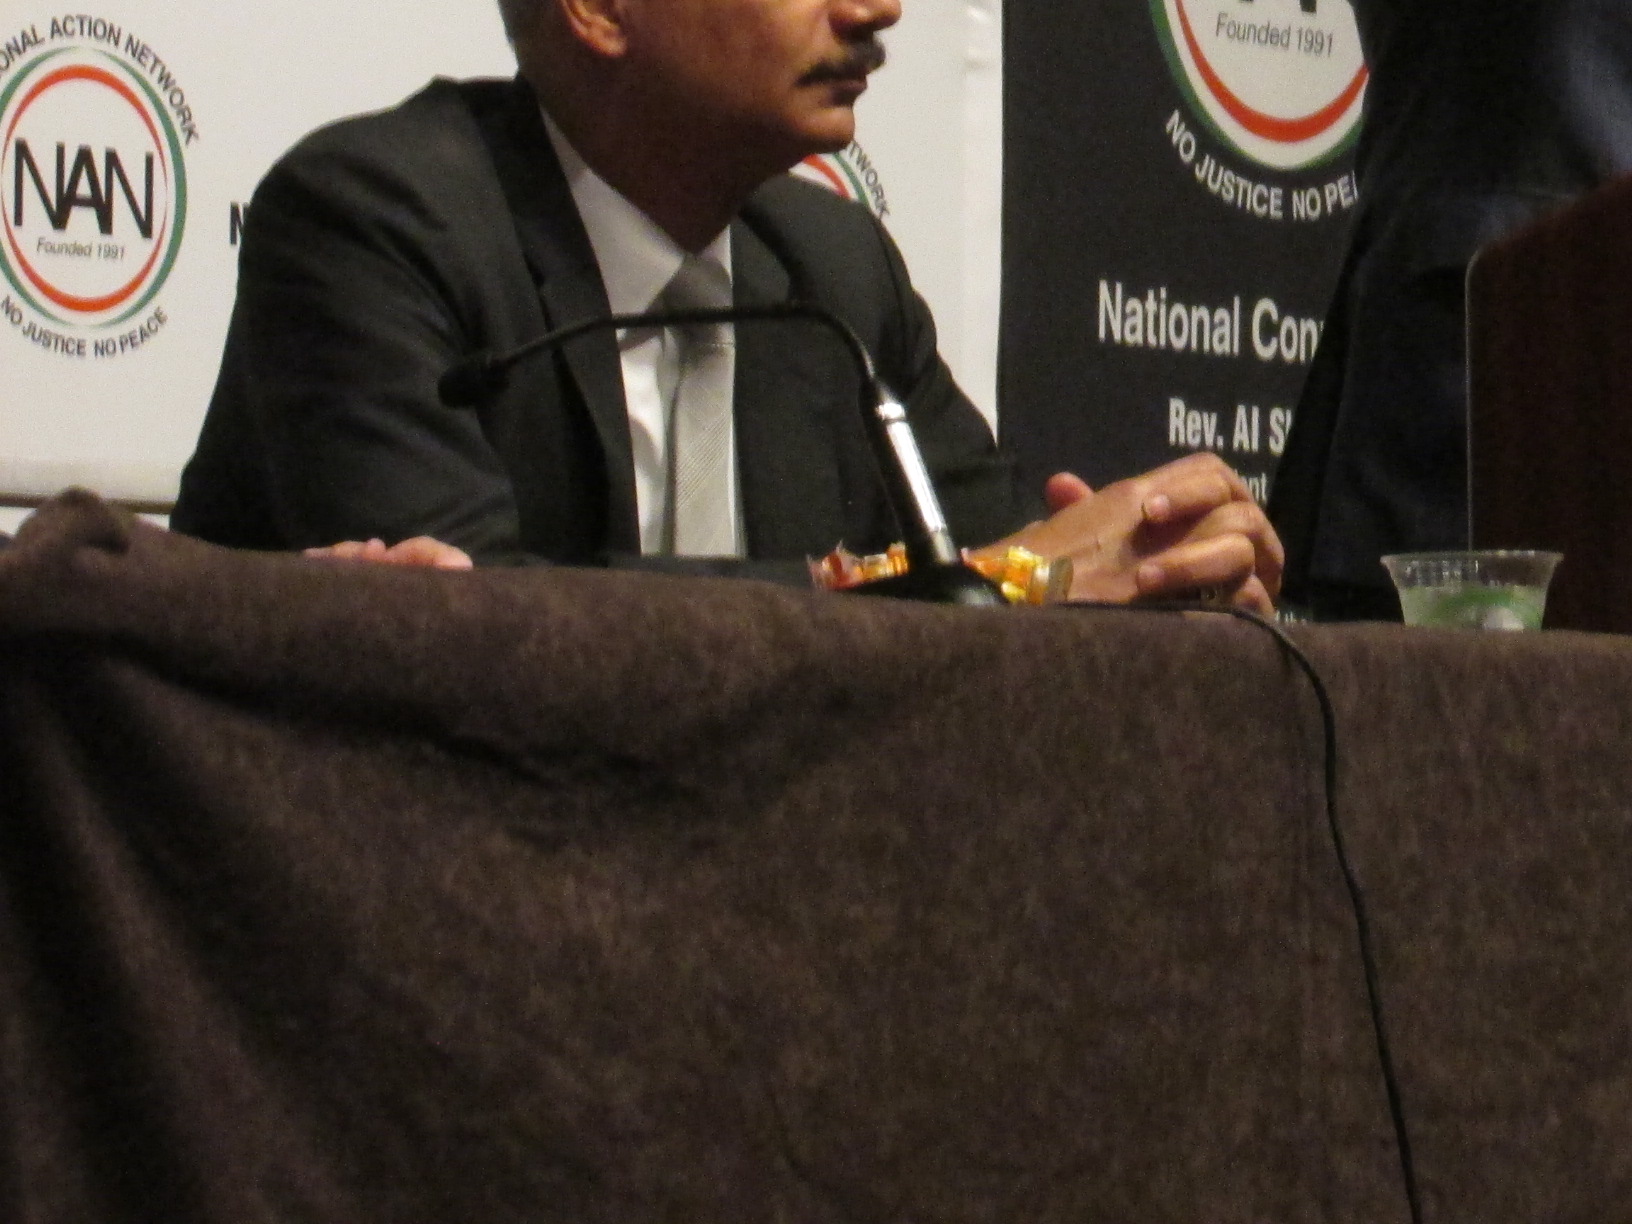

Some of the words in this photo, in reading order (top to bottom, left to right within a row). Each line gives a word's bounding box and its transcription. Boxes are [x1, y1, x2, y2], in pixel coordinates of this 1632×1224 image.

[1215, 12, 1291, 49] Founded
[1297, 28, 1334, 55] 1991
[50, 14, 122, 49] ACTION
[125, 33, 200, 147] NETWORK
[14, 136, 154, 240] NAN
[1166, 109, 1196, 164] NO
[1195, 152, 1285, 221] JUSTICE
[1292, 186, 1321, 222] NO
[36, 236, 92, 258] Founded
[97, 242, 125, 261] 1991
[1, 294, 23, 326] NO
[22, 321, 87, 357] JUSTICE
[93, 337, 117, 358] NO
[119, 305, 168, 355] PEACE
[1098, 278, 1242, 358] National
[1168, 397, 1224, 450] Rev.
